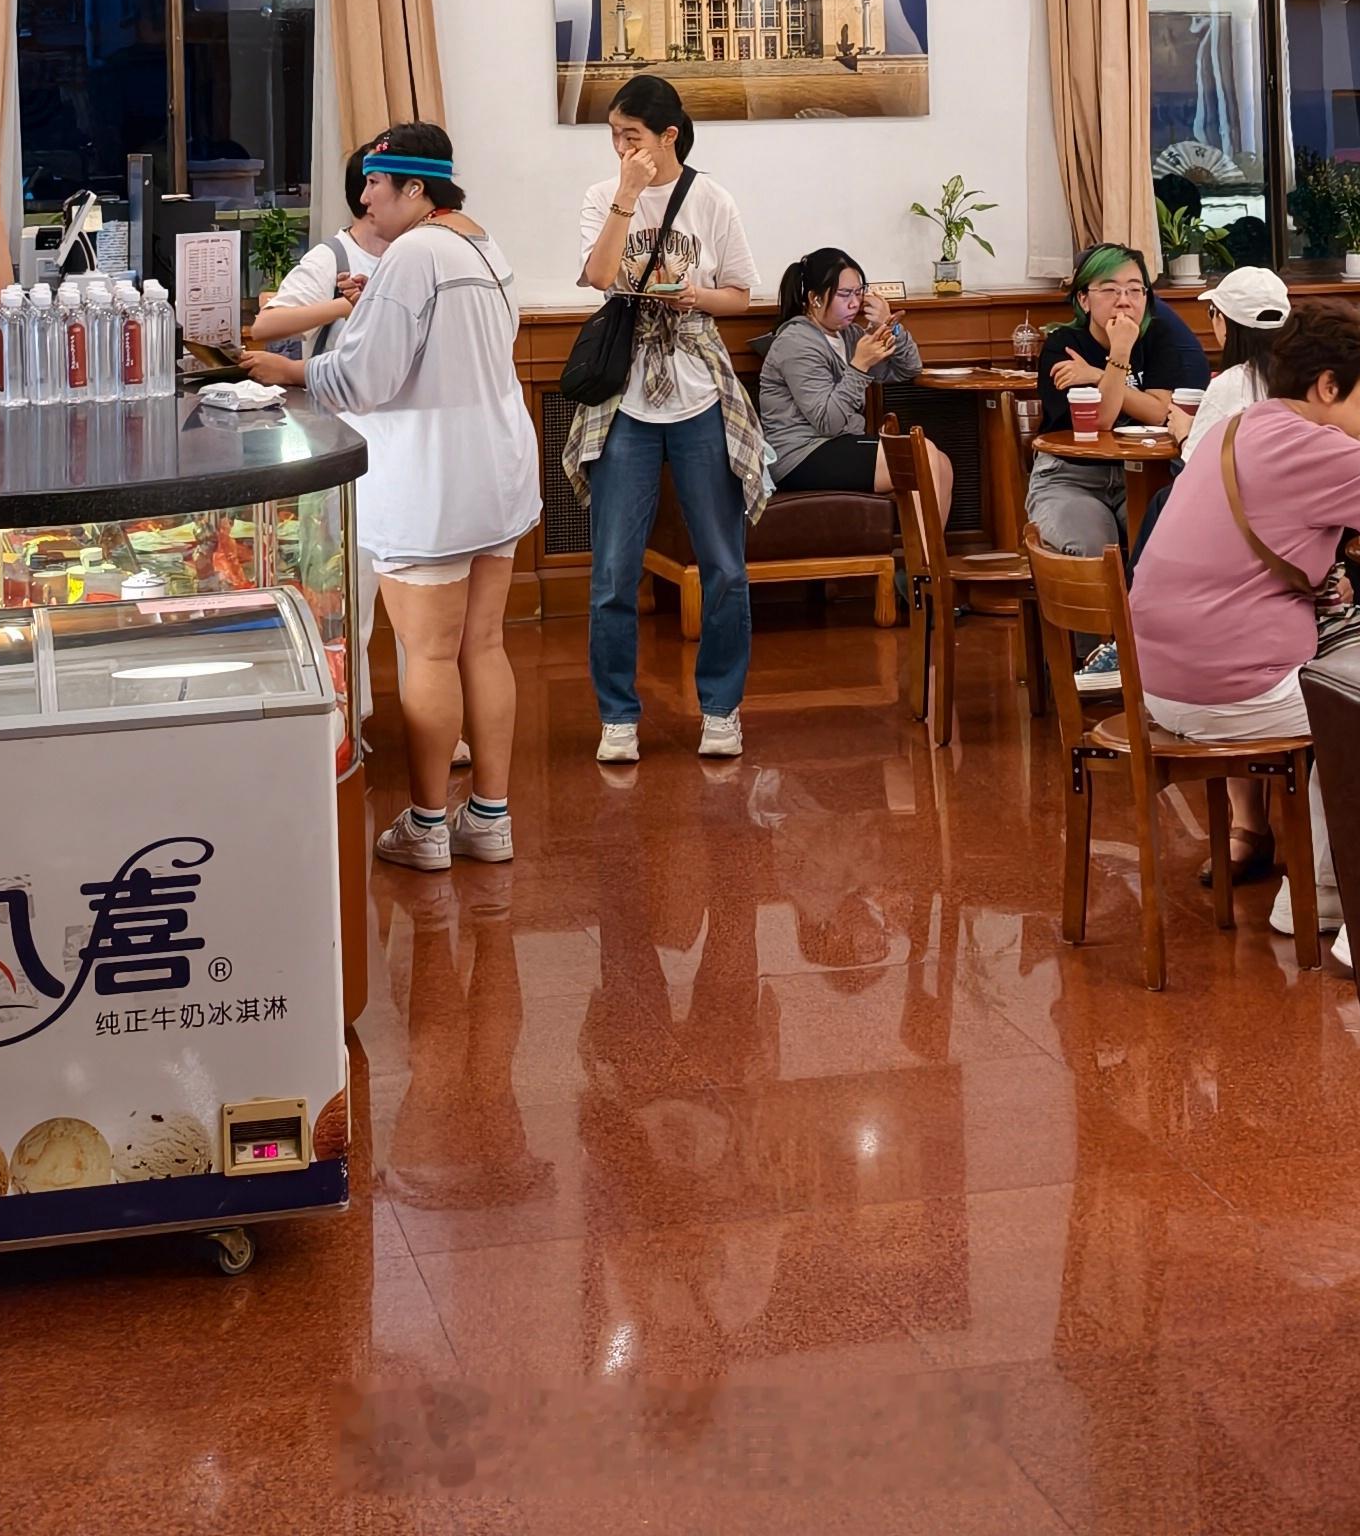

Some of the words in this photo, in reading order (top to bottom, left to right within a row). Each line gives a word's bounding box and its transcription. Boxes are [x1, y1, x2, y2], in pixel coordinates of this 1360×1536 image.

[94, 994, 289, 1037] 纯正牛奶冰淇淋
